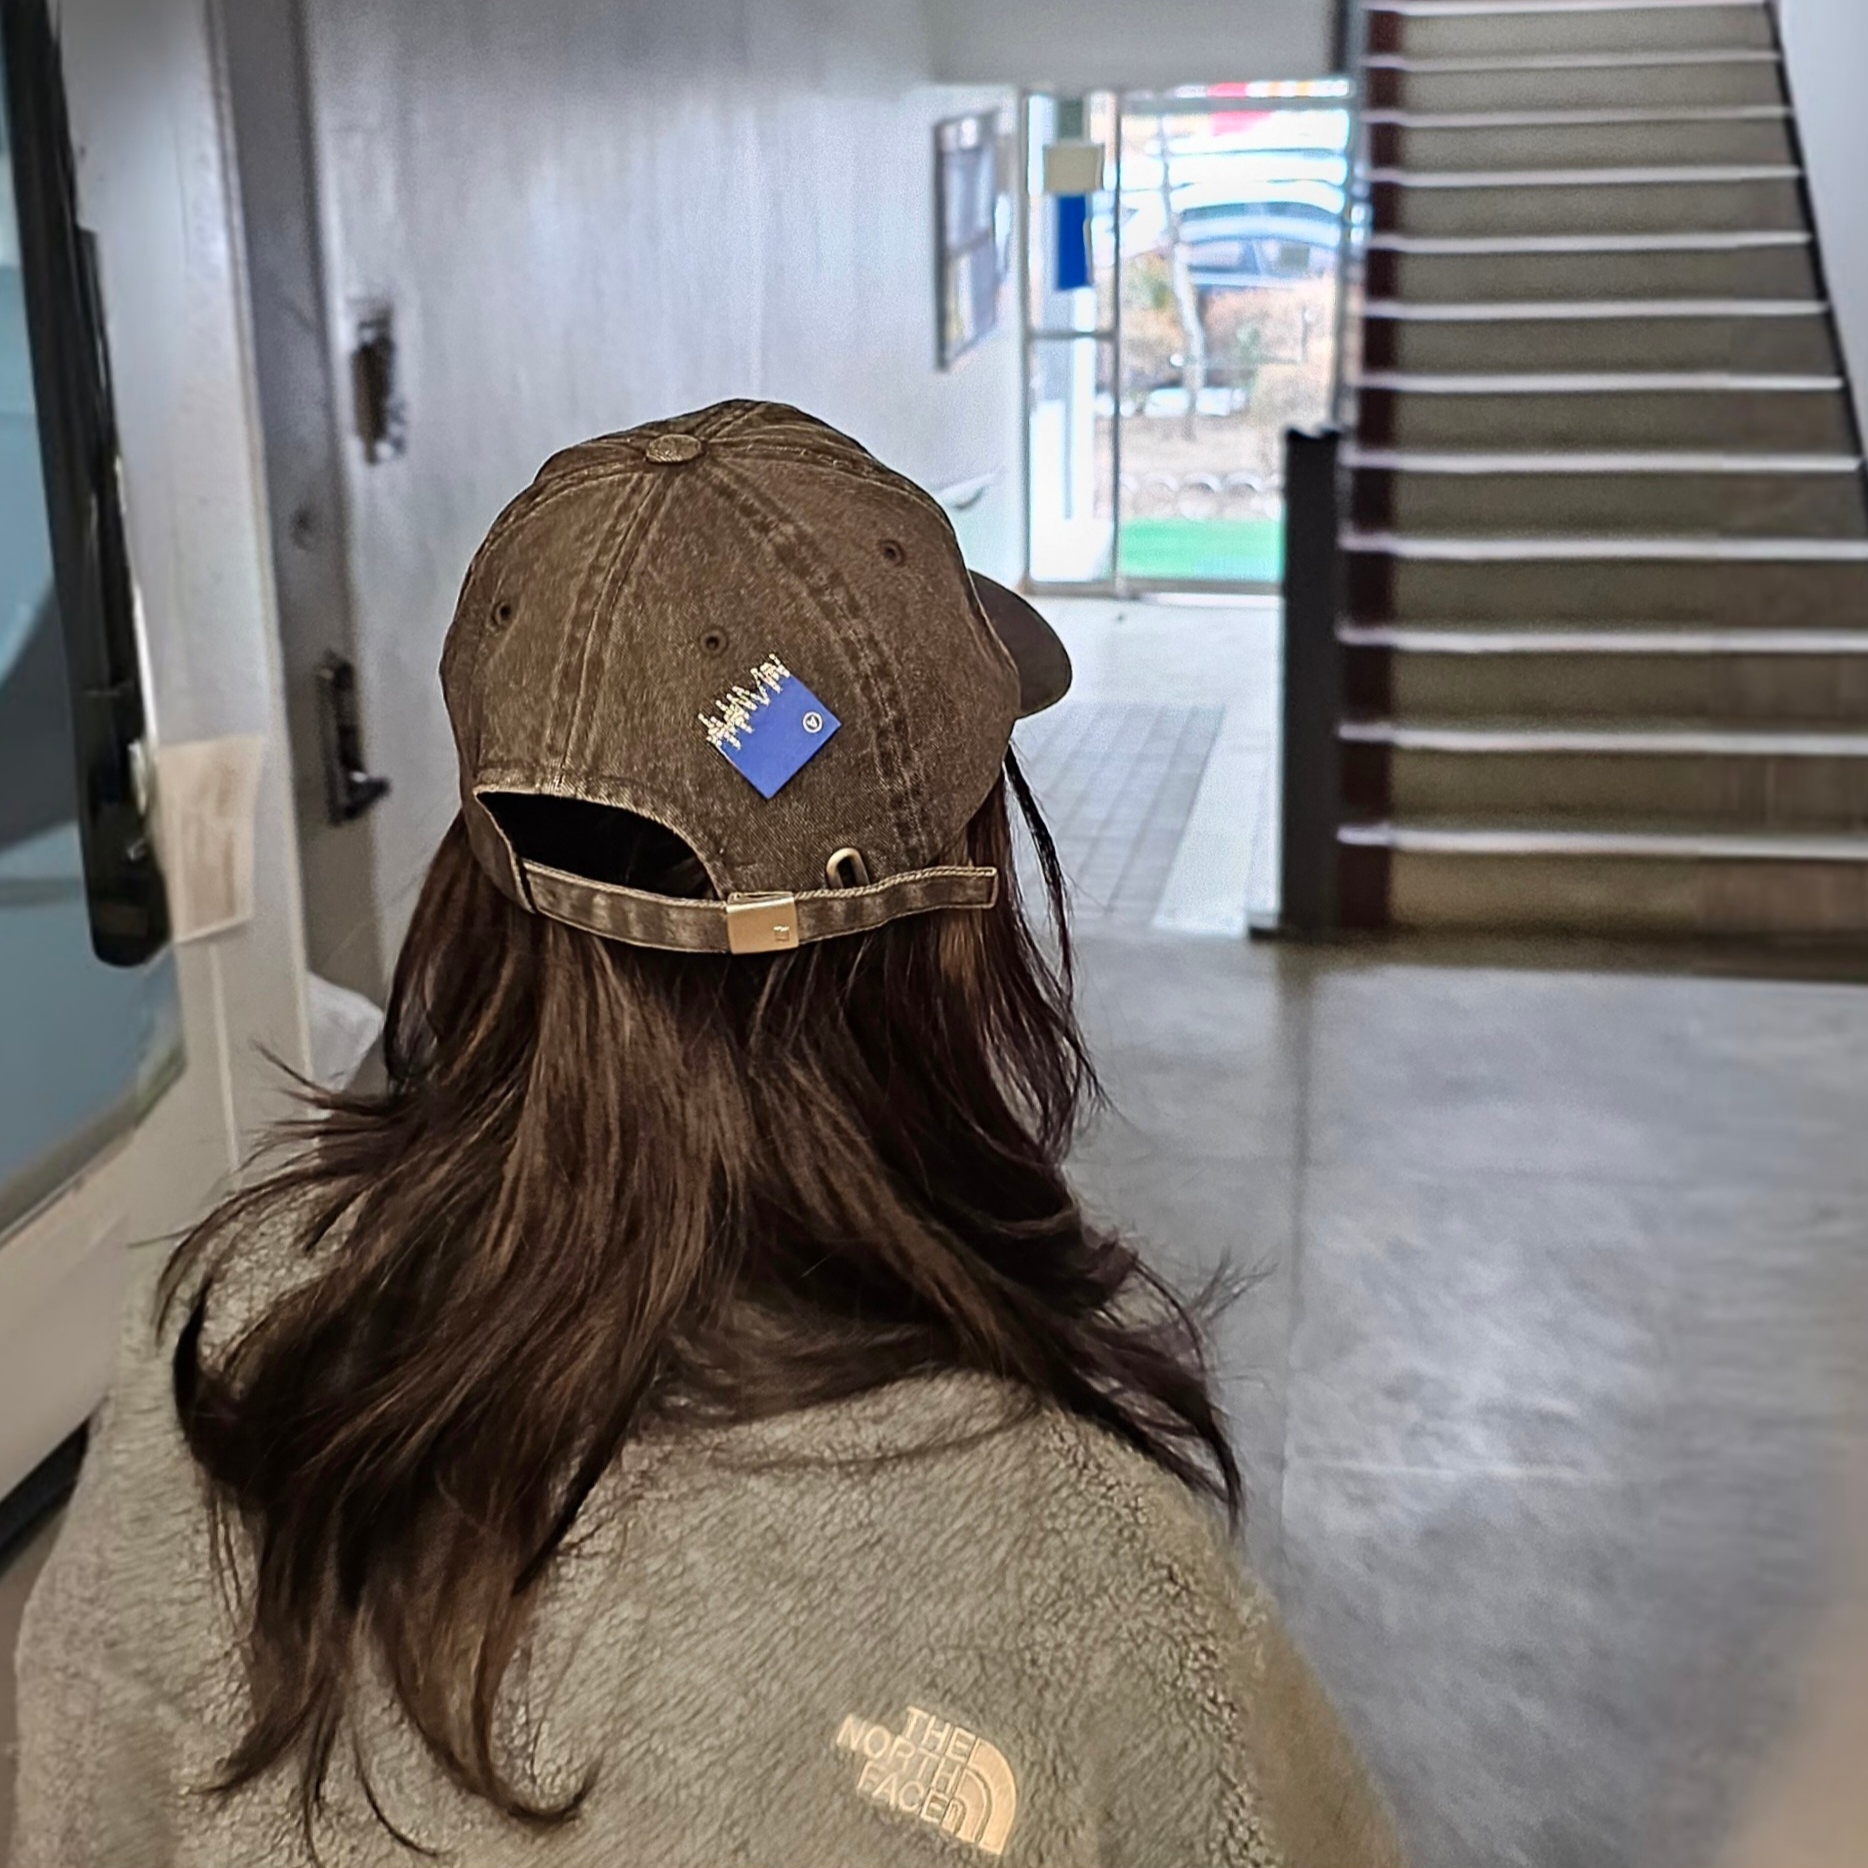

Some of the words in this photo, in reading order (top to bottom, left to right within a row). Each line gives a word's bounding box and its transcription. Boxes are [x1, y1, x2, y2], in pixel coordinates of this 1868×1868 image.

[836, 1714, 963, 1794] NORTH
[905, 1706, 976, 1762] THE
[856, 1761, 950, 1823] FACE
